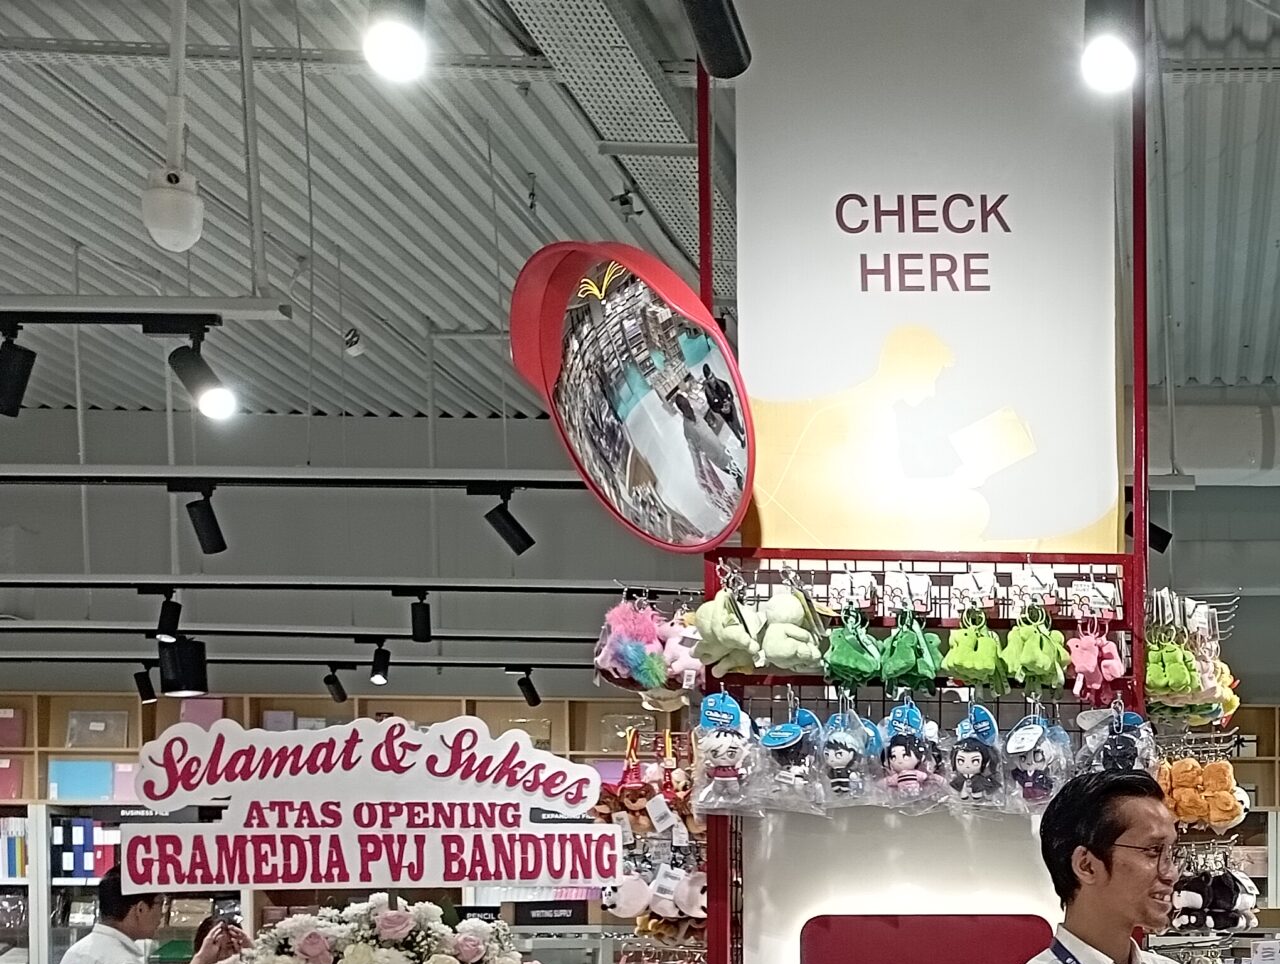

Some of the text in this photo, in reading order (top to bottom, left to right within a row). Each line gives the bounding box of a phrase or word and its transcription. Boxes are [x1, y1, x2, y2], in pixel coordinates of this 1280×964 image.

[834, 193, 1012, 234] CHECK
[859, 252, 991, 292] HERE
[143, 723, 591, 806] Selamat & Sukses
[120, 809, 153, 817] BUSINESS
[243, 801, 522, 829] ATAS OPENING
[126, 833, 618, 886] GRAMEDIA PVJ BANDUNG
[466, 912, 496, 922] PENCIL
[530, 909, 573, 919] WRITING SUPPLY
